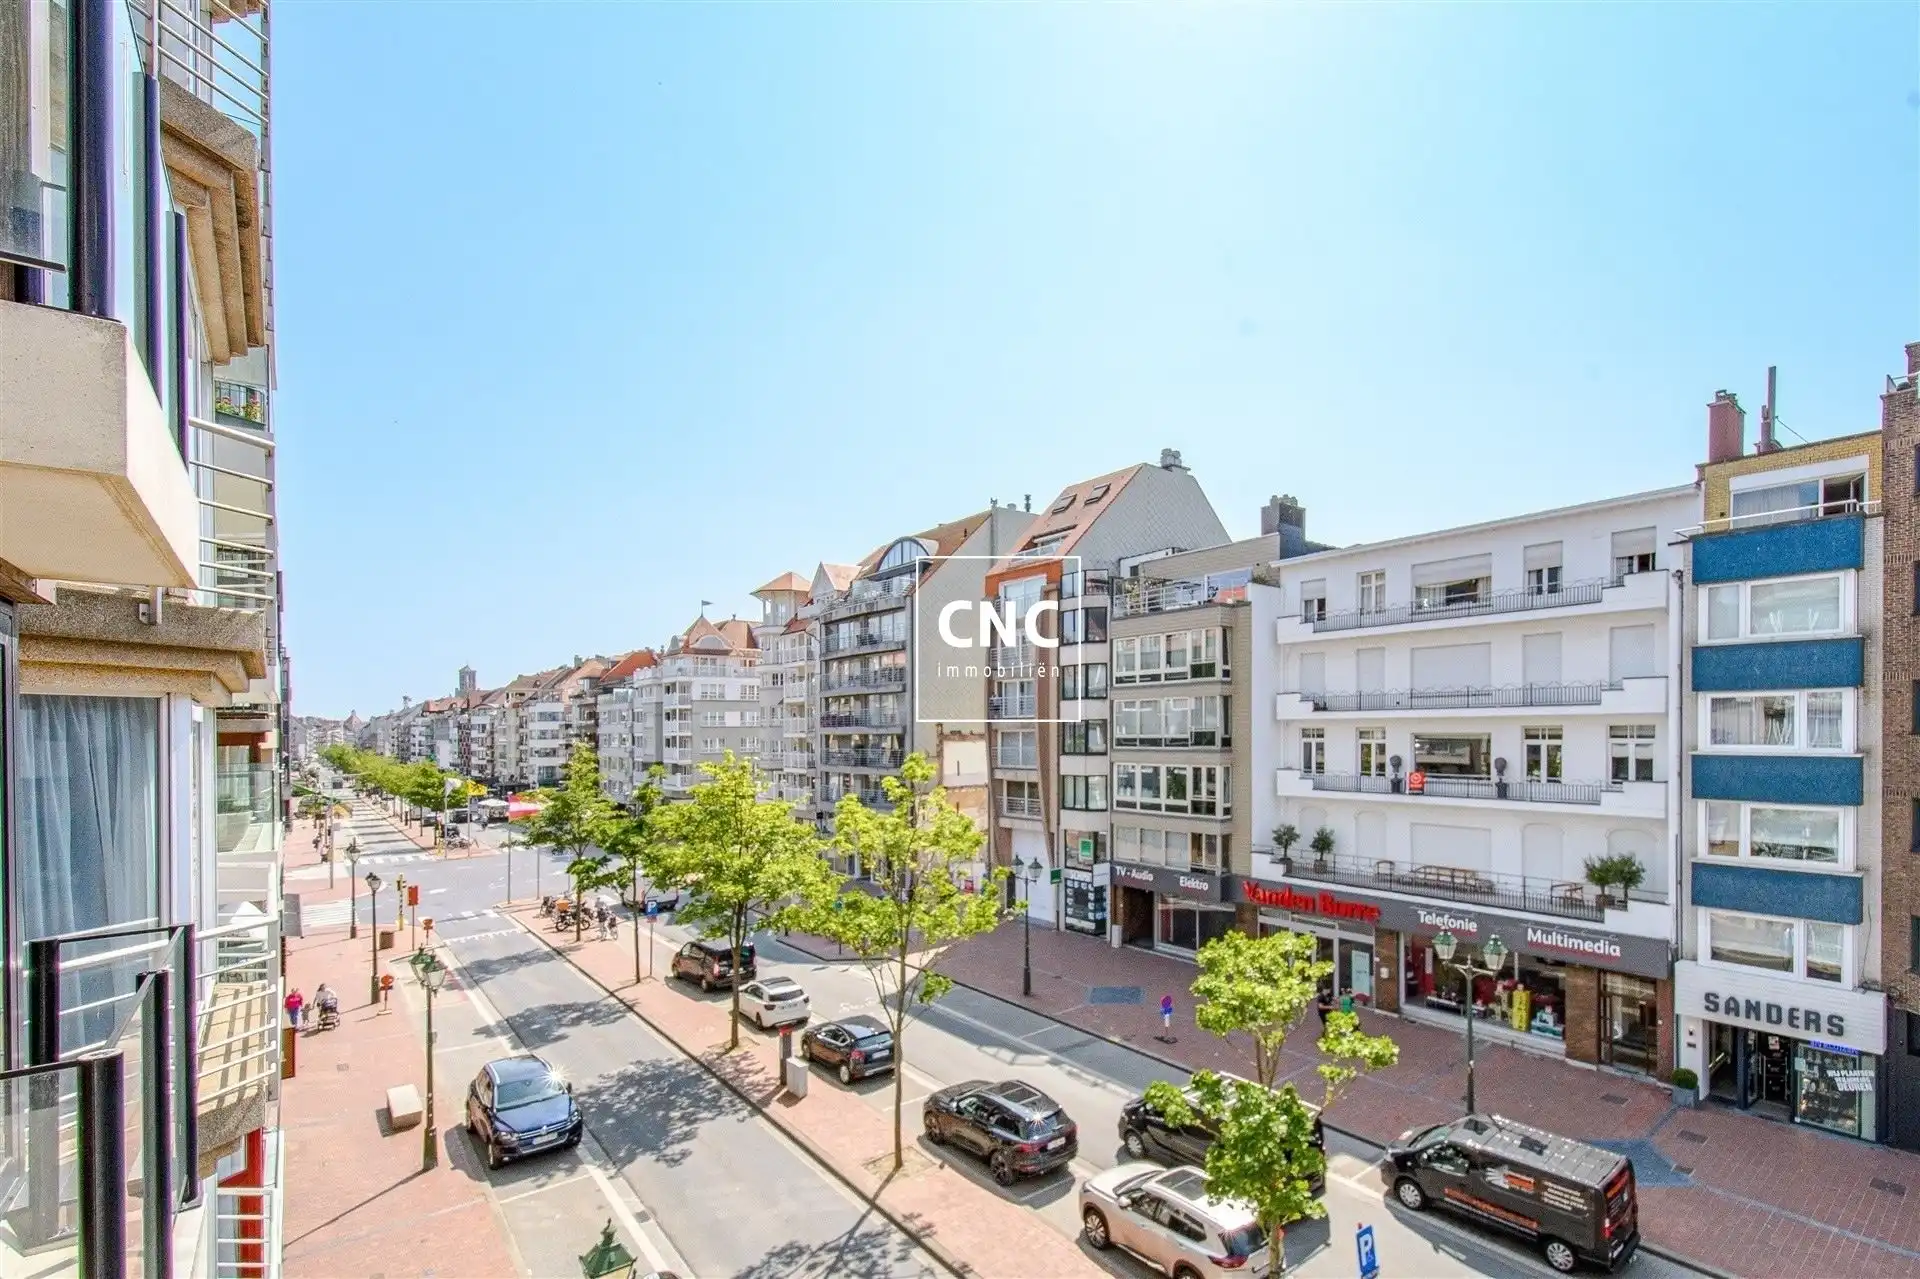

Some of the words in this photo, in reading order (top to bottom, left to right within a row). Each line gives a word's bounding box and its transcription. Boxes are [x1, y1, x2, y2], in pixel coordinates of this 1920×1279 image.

[1115, 866, 1127, 878] TV
[1131, 868, 1154, 882] Audio
[1179, 876, 1209, 892] Elektro
[647, 900, 657, 913] P
[1243, 880, 1317, 914] Vanden
[1417, 910, 1478, 933] Telefonie
[1527, 928, 1621, 957] Multimedia
[1704, 992, 1844, 1037] SANDERS
[1360, 1232, 1373, 1267] P
